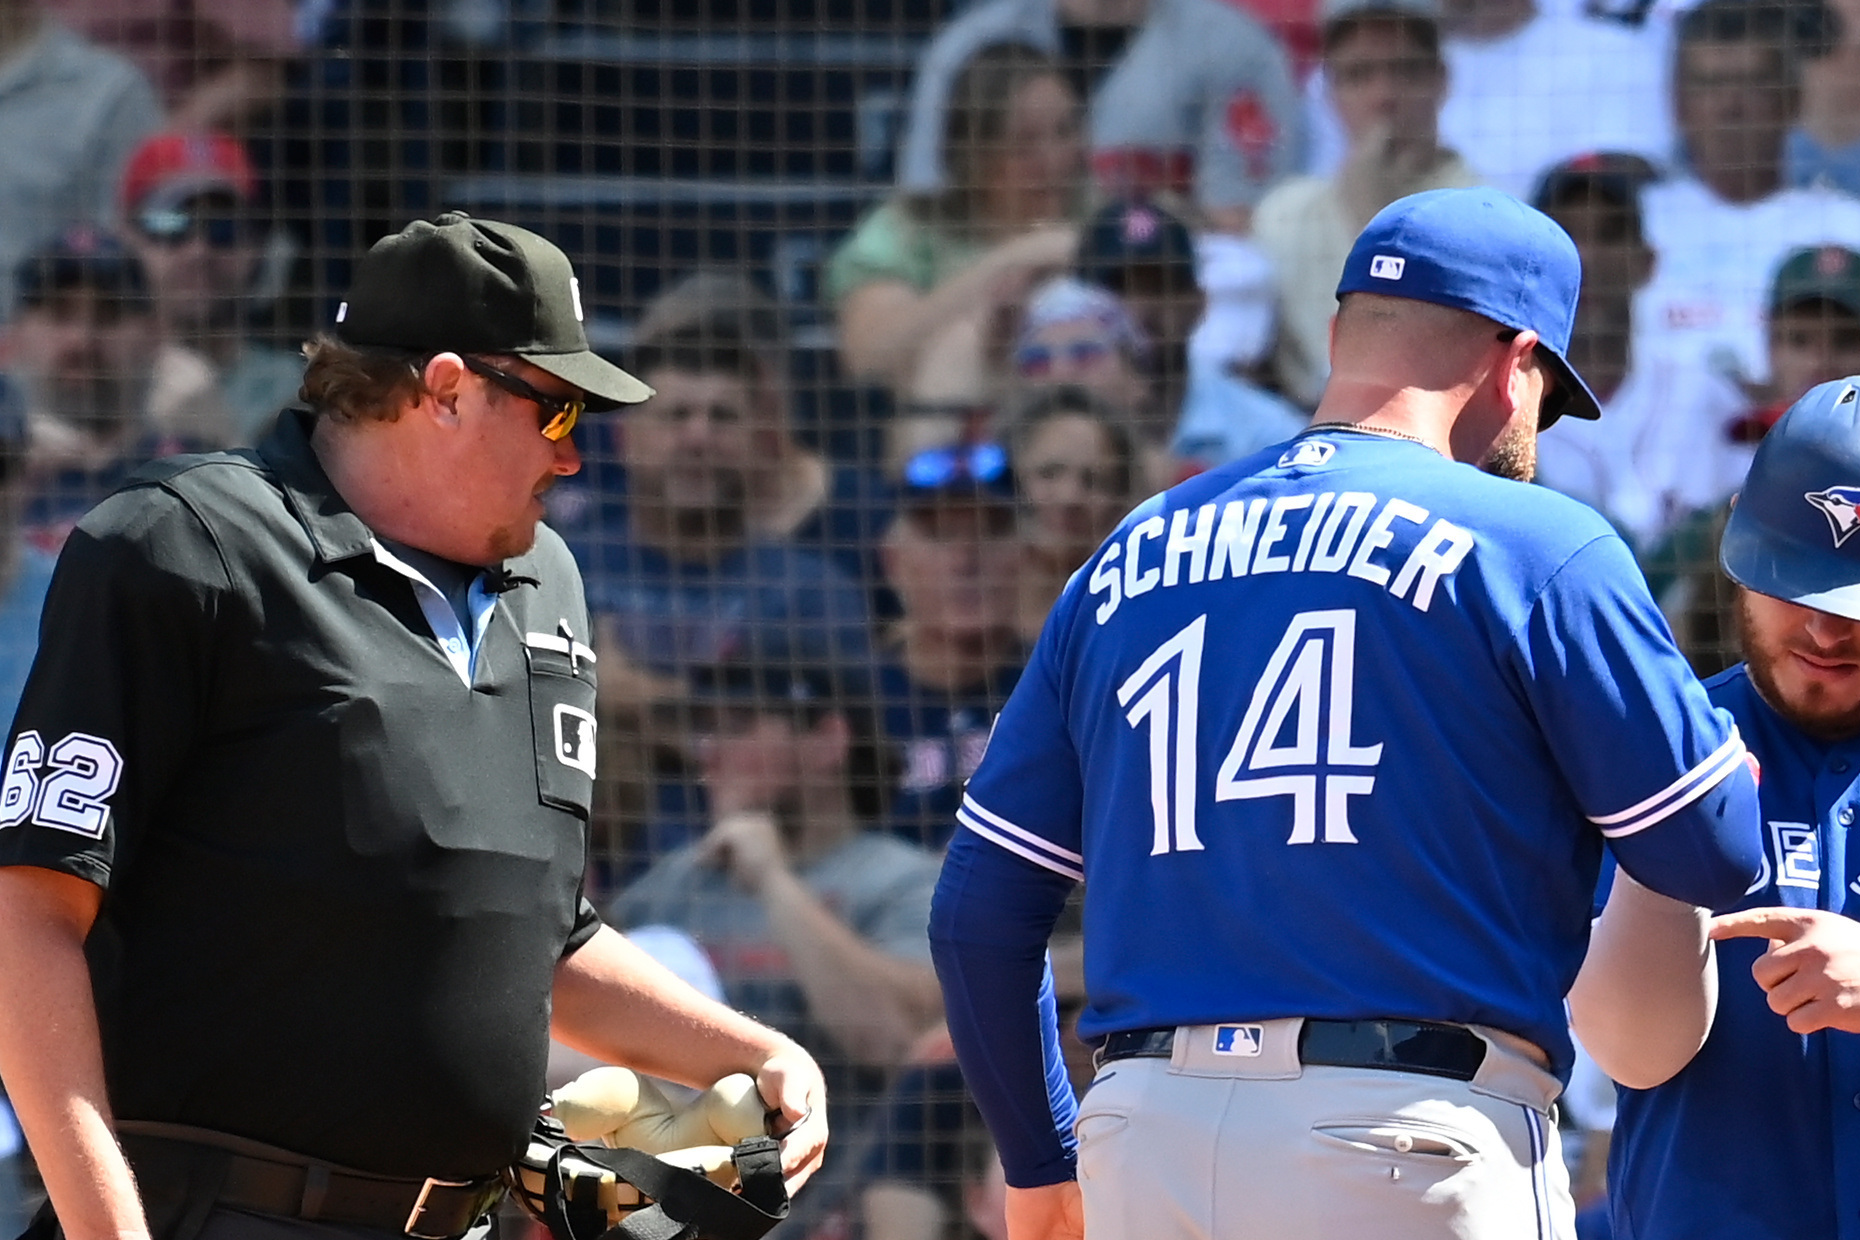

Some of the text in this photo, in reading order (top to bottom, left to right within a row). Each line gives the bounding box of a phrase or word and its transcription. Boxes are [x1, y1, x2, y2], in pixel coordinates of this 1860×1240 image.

[1088, 491, 1475, 626] SCHNEIDER
[0, 730, 124, 840] 62
[1116, 608, 1384, 857] 14
